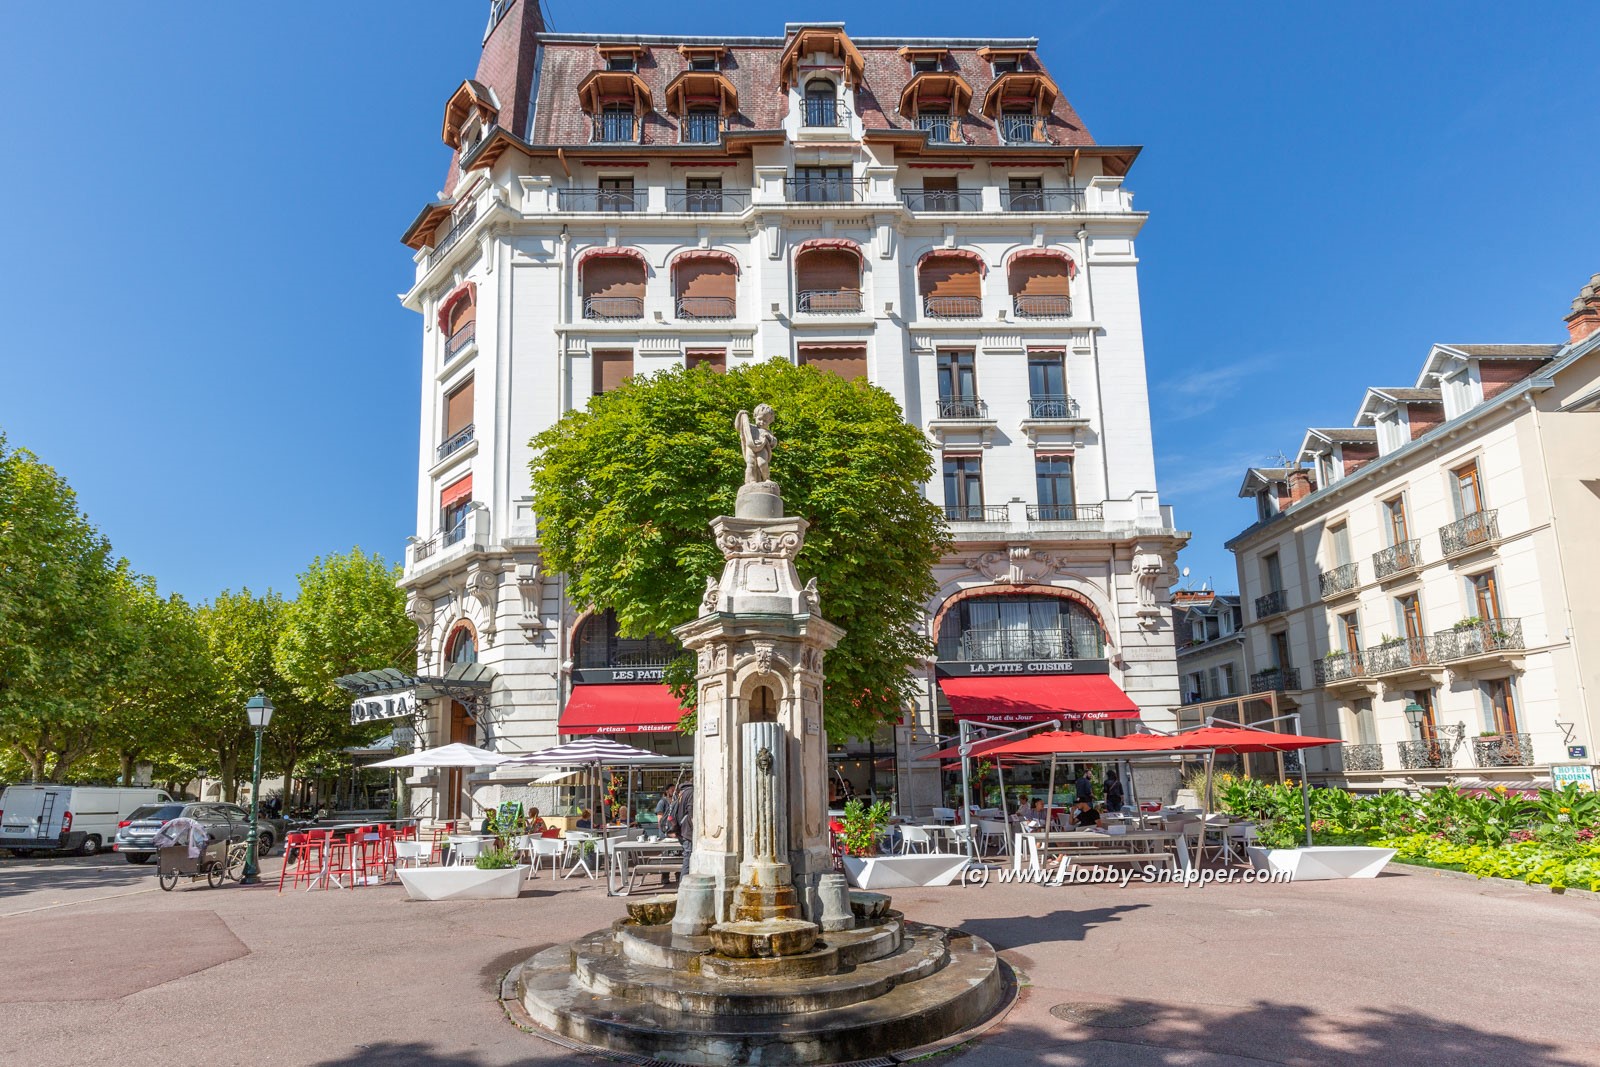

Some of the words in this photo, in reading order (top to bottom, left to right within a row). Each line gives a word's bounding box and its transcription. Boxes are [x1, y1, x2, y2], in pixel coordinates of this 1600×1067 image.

[970, 664, 985, 673] LA
[987, 663, 1023, 672] P'TITE
[1027, 662, 1073, 671] CUISINE
[612, 671, 634, 680] LES
[1087, 712, 1109, 720] Cafés
[1558, 766, 1587, 774] HOTEL
[1555, 773, 1592, 781] BROISIN
